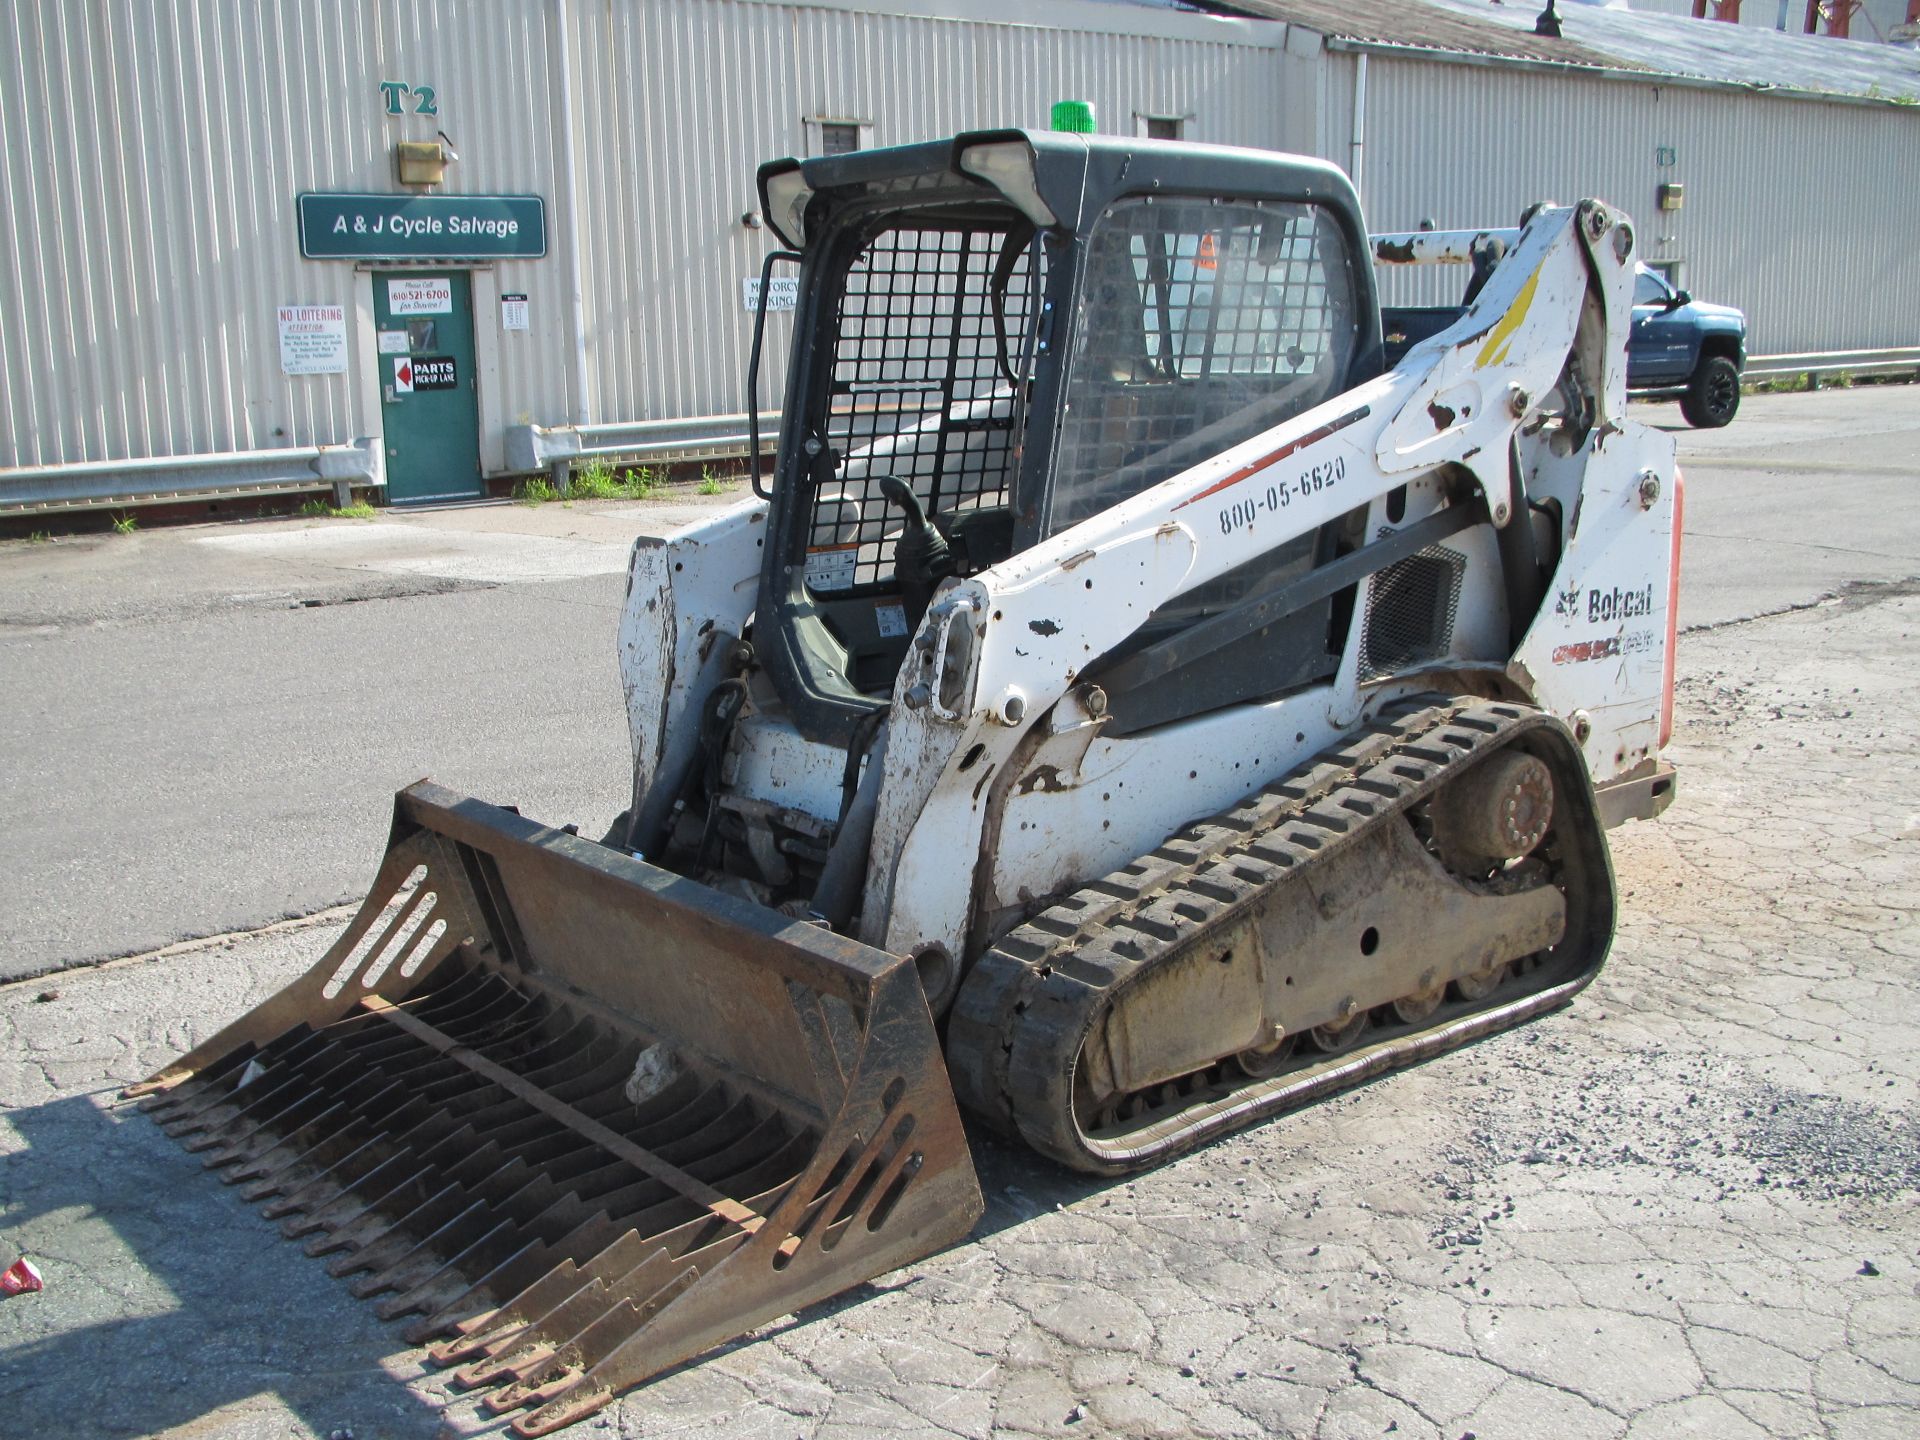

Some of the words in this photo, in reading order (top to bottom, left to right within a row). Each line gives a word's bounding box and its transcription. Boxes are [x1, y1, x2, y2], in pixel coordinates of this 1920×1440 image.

[379, 81, 438, 117] T2
[333, 215, 348, 234] A
[353, 215, 368, 234] &
[373, 215, 384, 234] J
[390, 215, 443, 238] Cycle
[449, 215, 519, 239] Salvage
[400, 301, 411, 312] for
[748, 296, 794, 307] PAKING
[280, 309, 293, 322] NO
[297, 308, 342, 321] LOITERING
[414, 362, 454, 375] PARTS
[415, 374, 438, 384] PICK-UP
[440, 373, 455, 383] LANE
[1220, 456, 1345, 535] 800-05-6620
